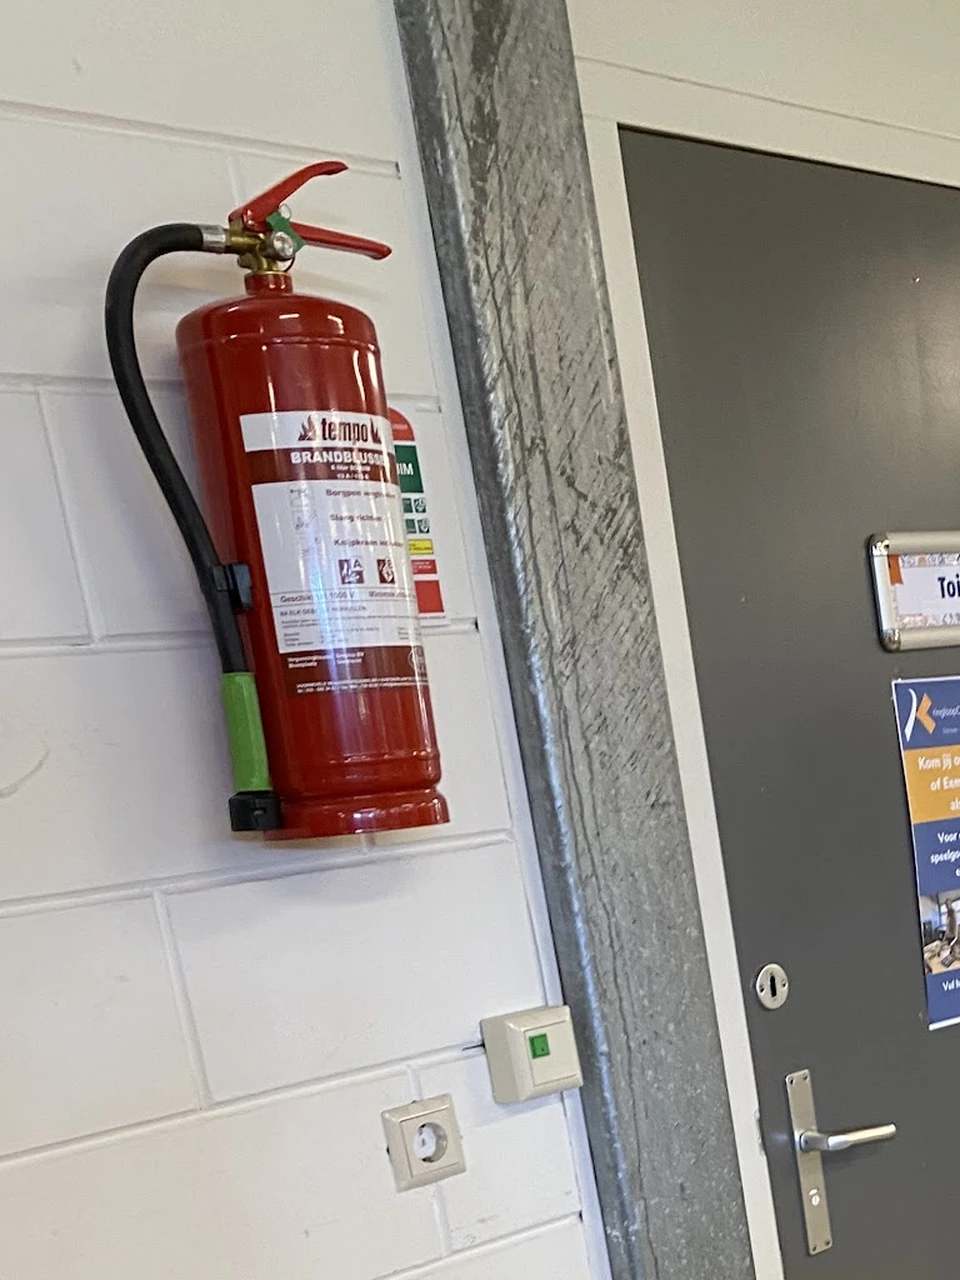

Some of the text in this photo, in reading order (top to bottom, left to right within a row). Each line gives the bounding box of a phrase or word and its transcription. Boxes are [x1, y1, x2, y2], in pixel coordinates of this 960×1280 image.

[321, 418, 368, 445] tempo
[918, 757, 940, 770] Kom
[942, 753, 952, 770] jij
[930, 777, 940, 791] of
[937, 832, 957, 843] Voor
[942, 981, 954, 991] Vul
